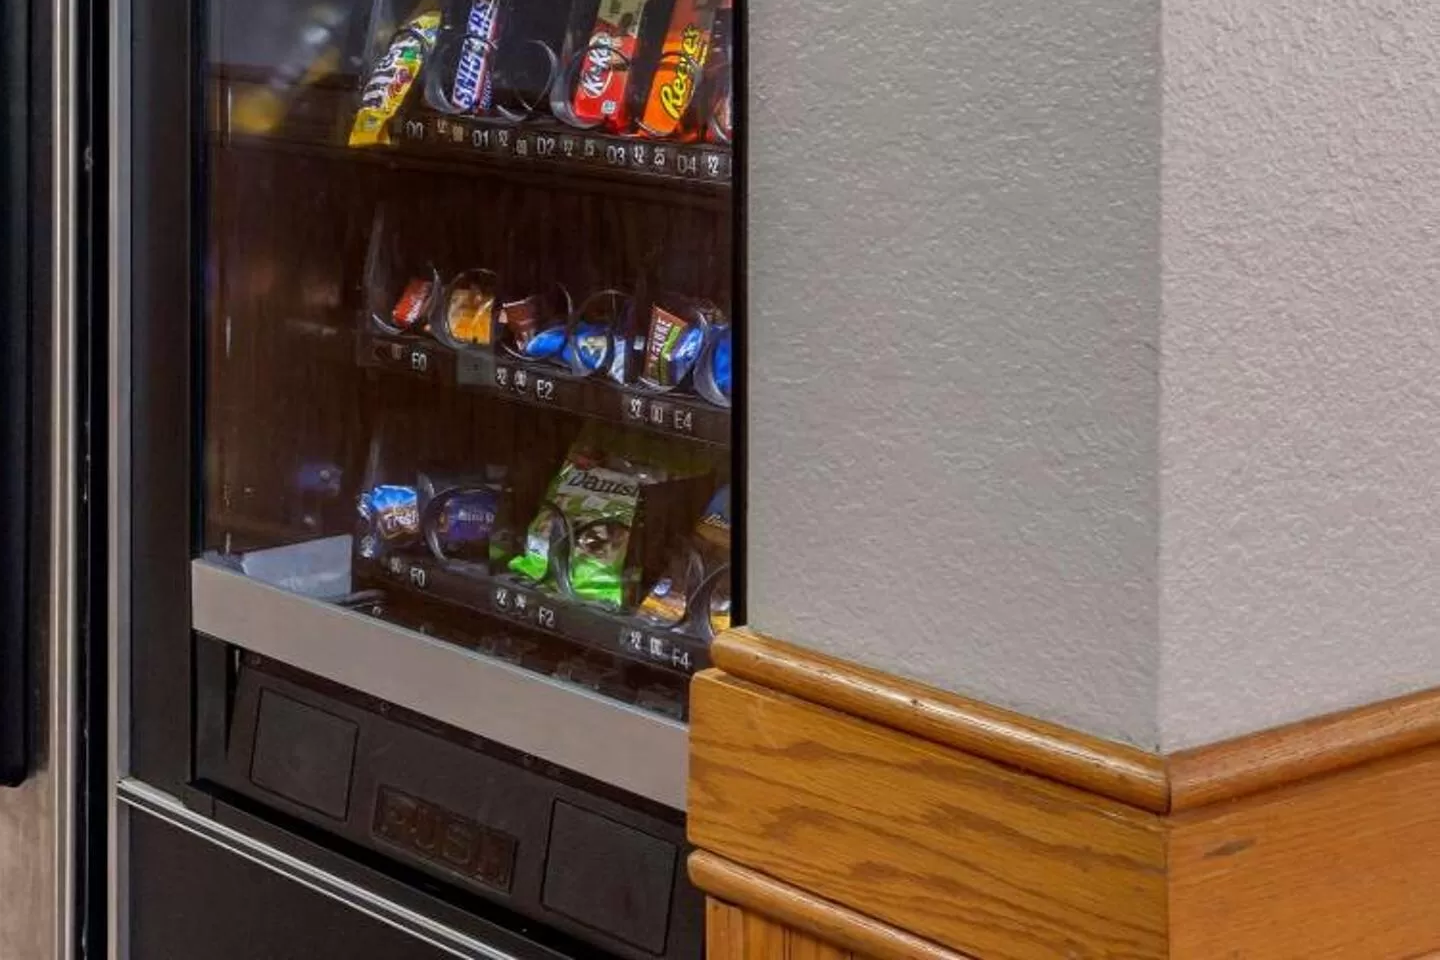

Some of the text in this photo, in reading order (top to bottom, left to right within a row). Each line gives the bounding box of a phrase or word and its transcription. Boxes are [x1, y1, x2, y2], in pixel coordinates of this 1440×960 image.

[536, 379, 554, 400] E2
[674, 409, 693, 431] E4
[538, 606, 554, 628] F2
[671, 648, 692, 670] F4
